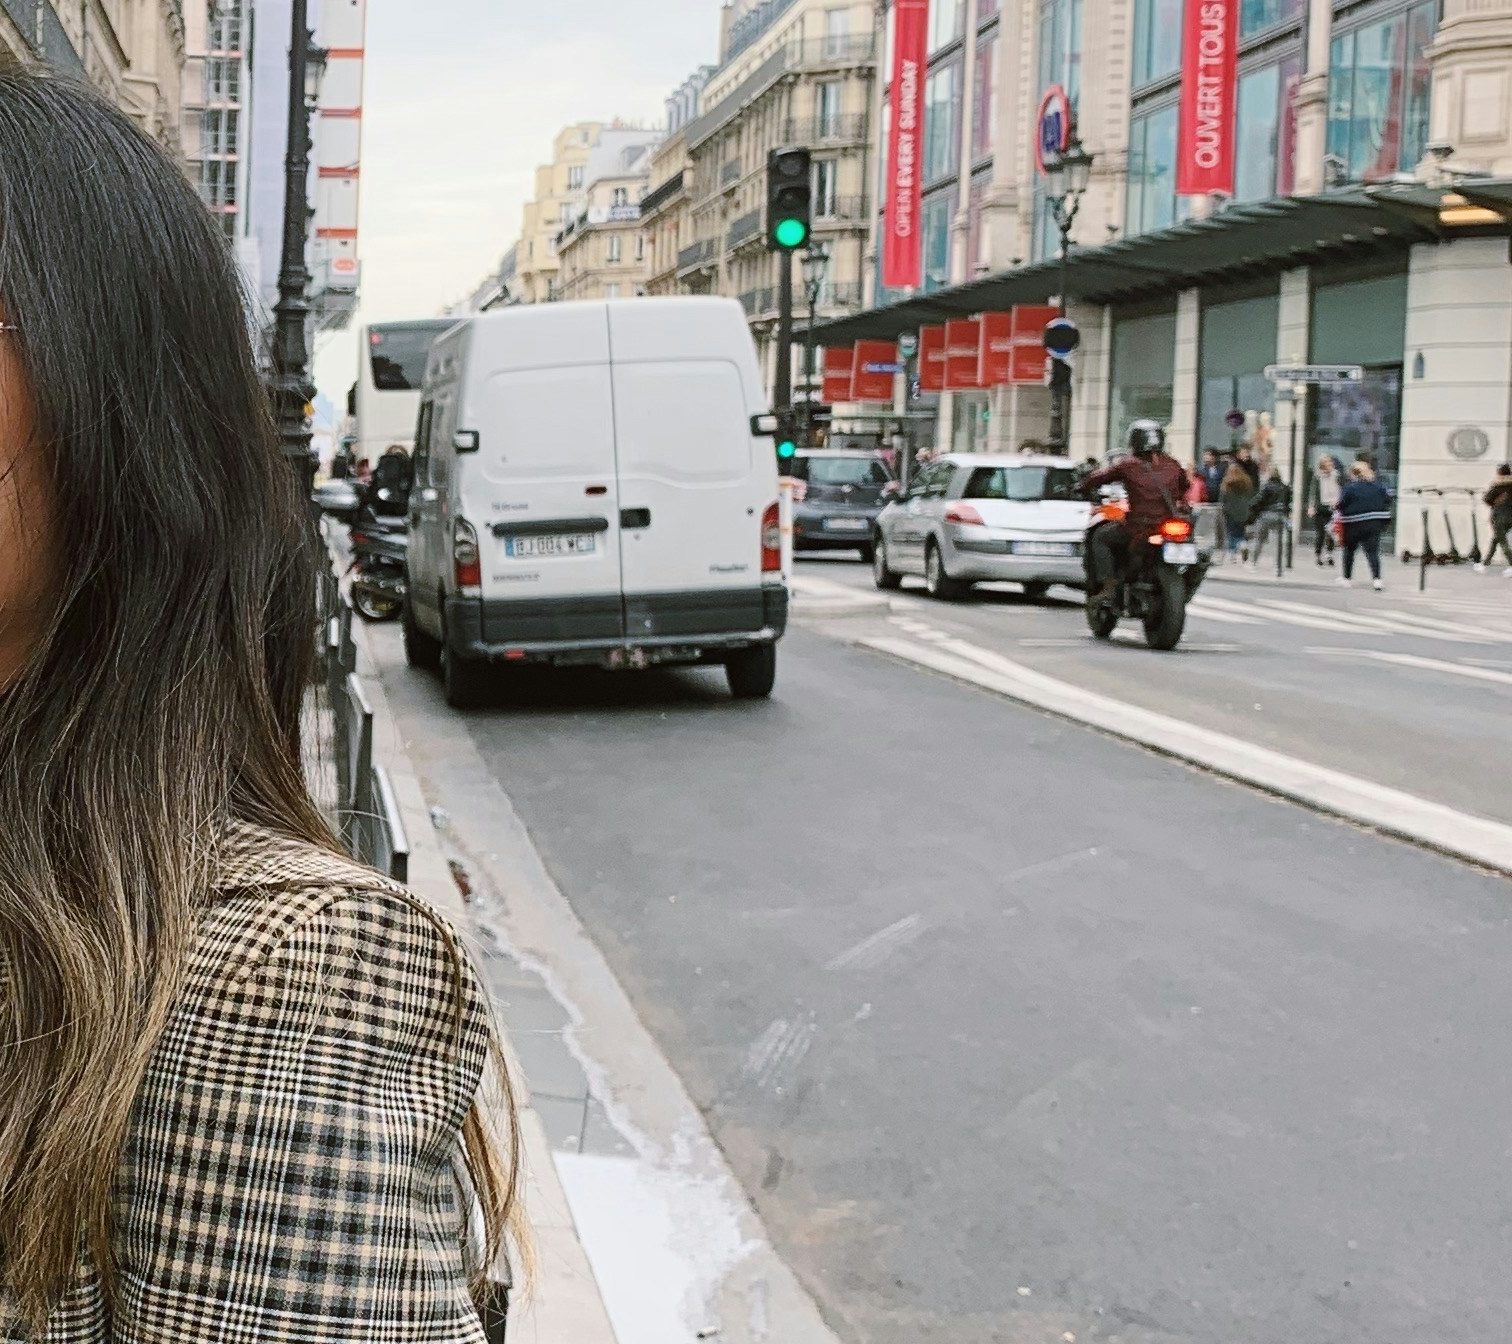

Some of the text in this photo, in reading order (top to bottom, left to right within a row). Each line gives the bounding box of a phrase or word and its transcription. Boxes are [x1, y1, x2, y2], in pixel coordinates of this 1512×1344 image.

[1199, 4, 1225, 65] TOUS
[895, 60, 918, 237] OPEN EVERY SUNDAY
[1195, 73, 1224, 169] OUVERT
